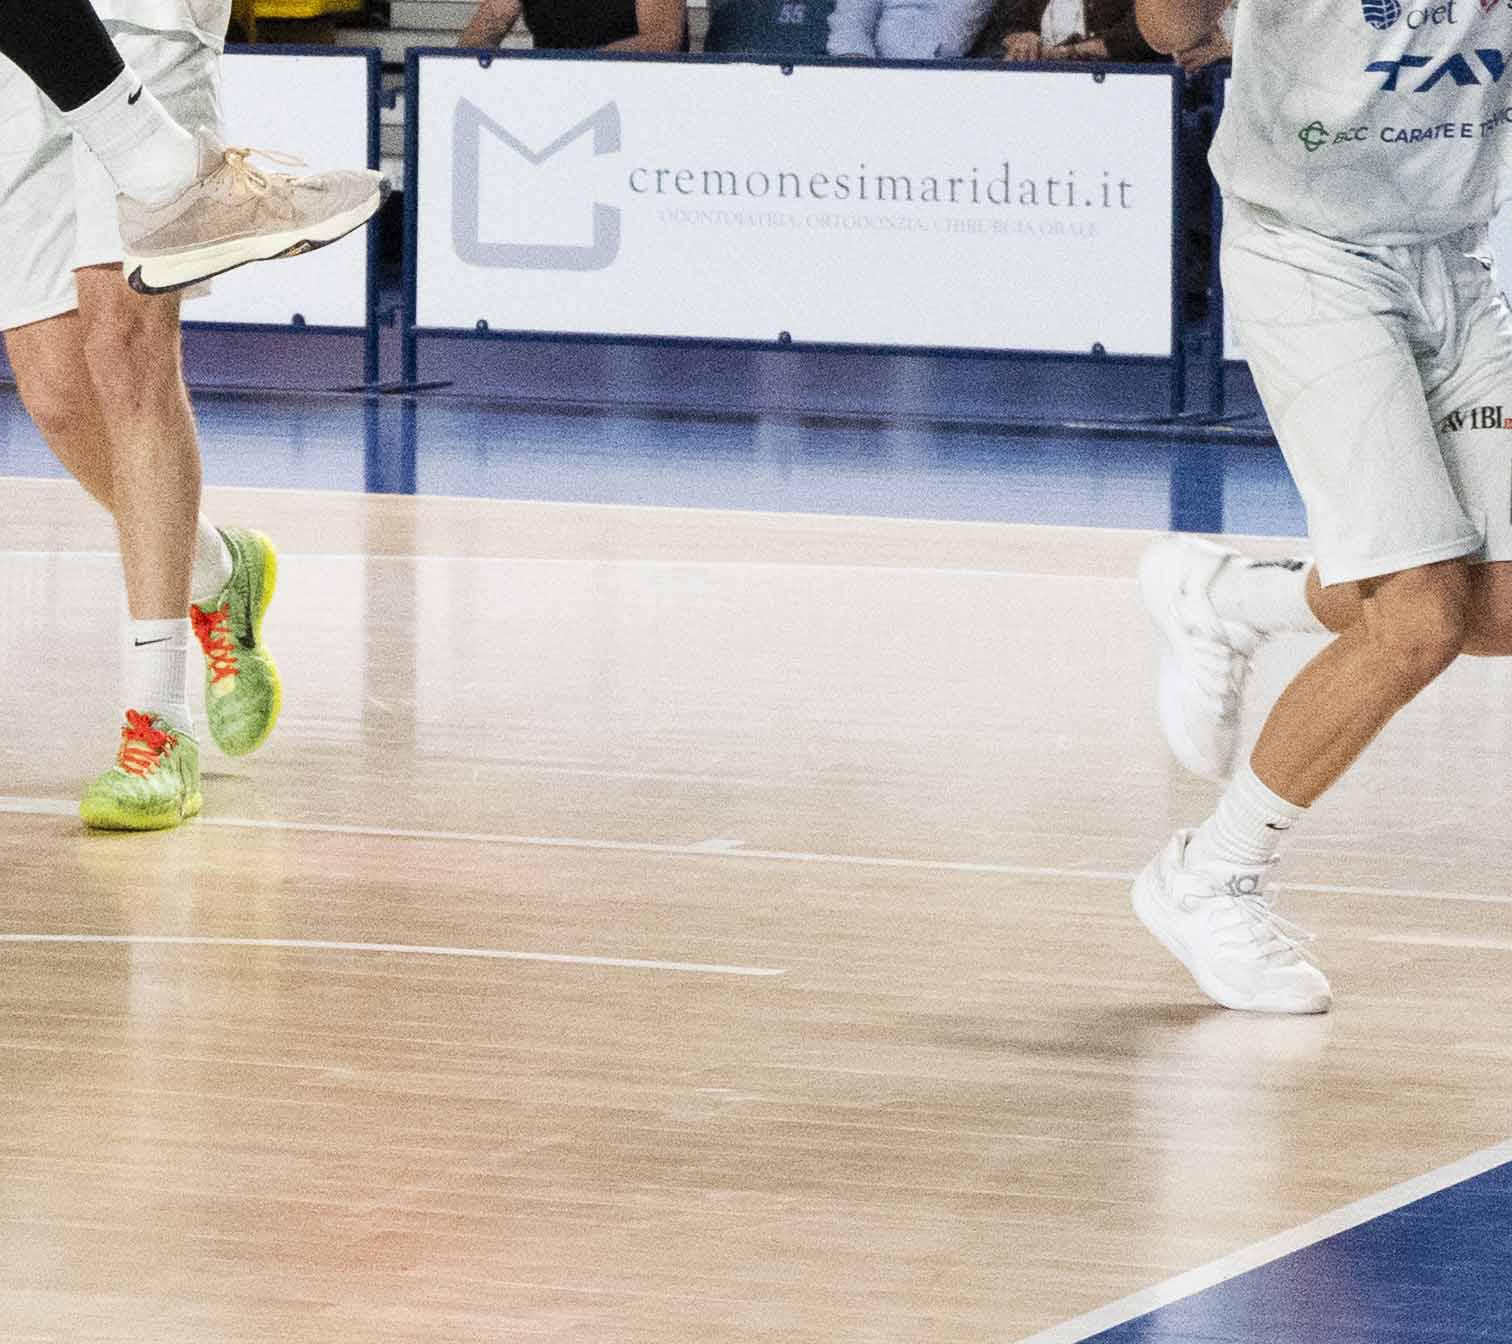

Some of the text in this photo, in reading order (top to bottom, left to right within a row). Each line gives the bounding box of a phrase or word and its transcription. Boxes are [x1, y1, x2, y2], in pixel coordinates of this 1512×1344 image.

[1380, 122, 1455, 144] CARATE
[1460, 122, 1473, 139] E
[628, 162, 1134, 211] cremonesimaridati.it
